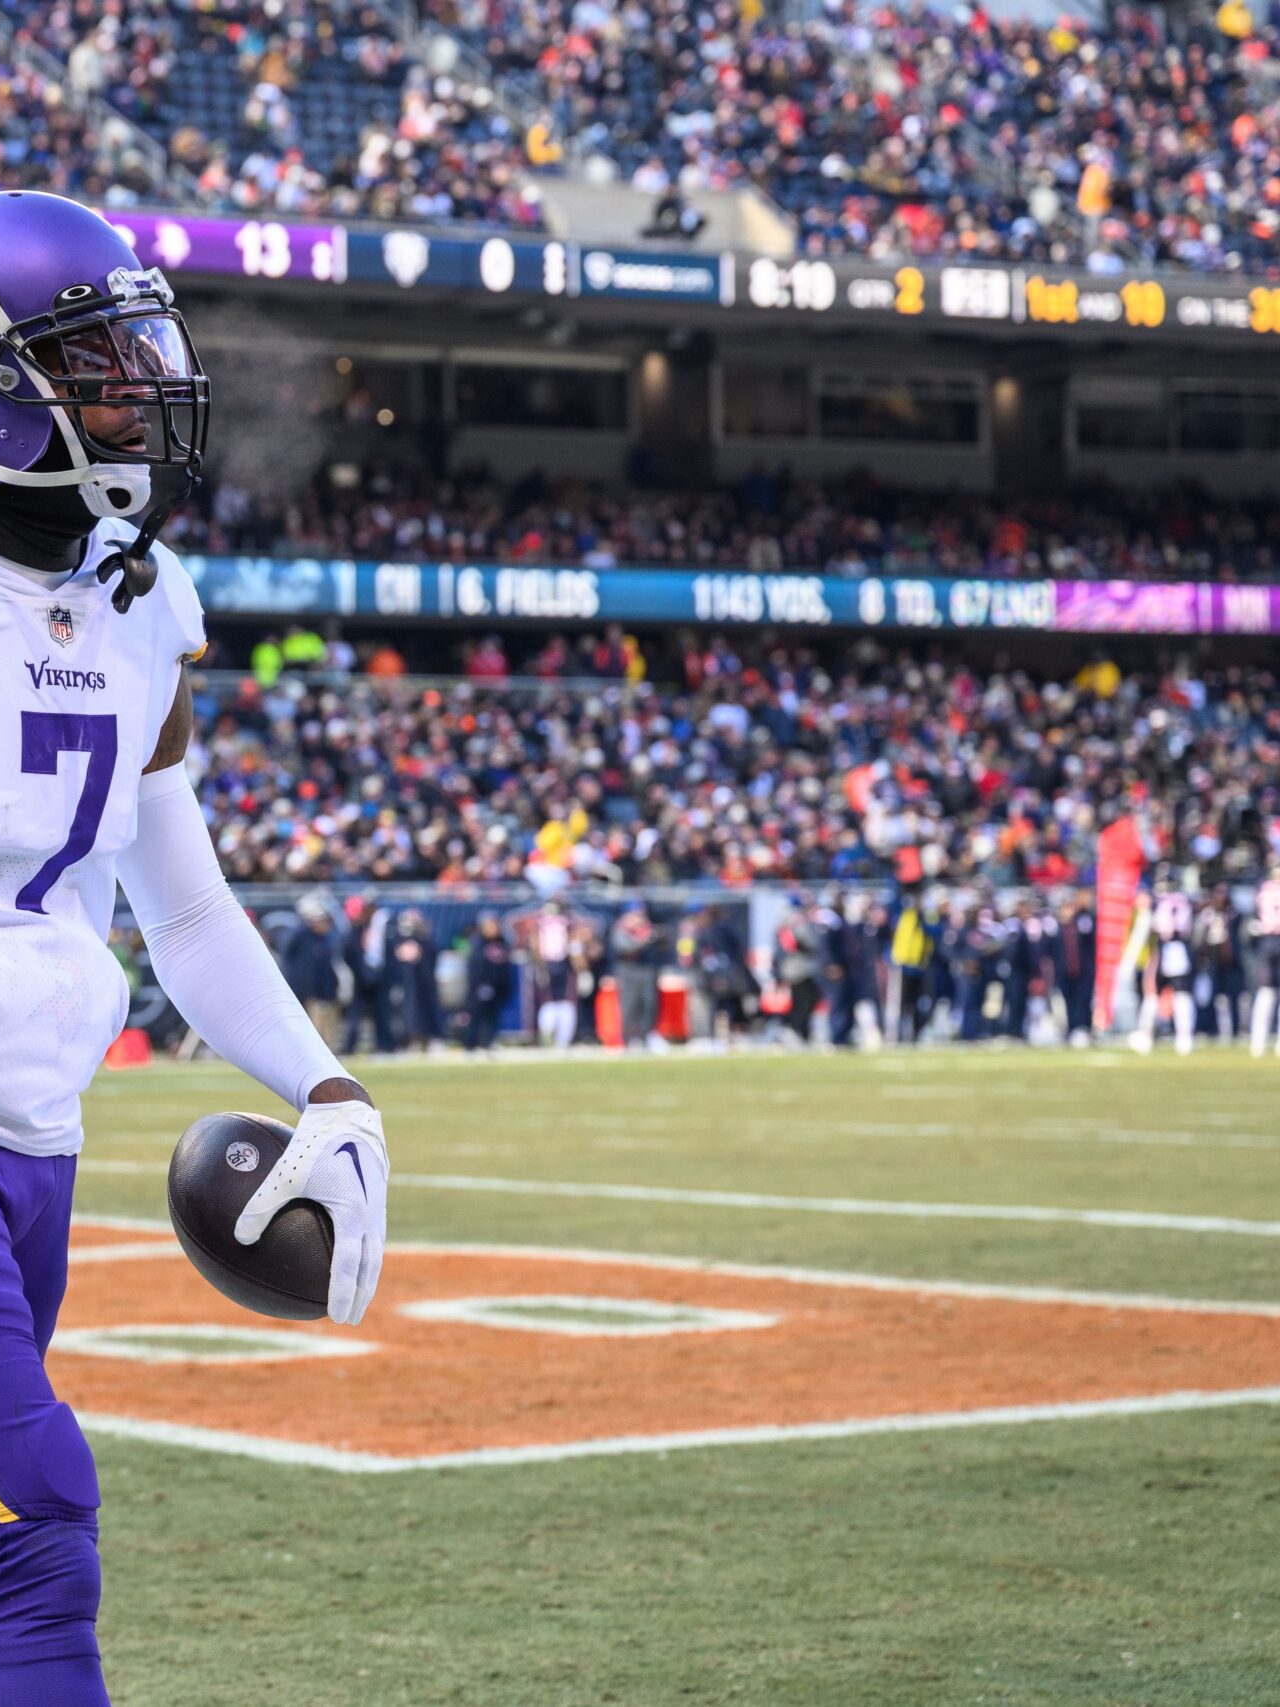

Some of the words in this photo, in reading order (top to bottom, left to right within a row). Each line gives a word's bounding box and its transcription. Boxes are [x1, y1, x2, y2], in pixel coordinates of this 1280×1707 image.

[235, 221, 291, 277] 13
[481, 238, 514, 291] 0
[895, 266, 924, 315] 2
[1121, 280, 1165, 327] 10
[496, 568, 601, 619] FIELDS
[52, 622, 72, 638] NFL
[15, 711, 118, 915] 7
